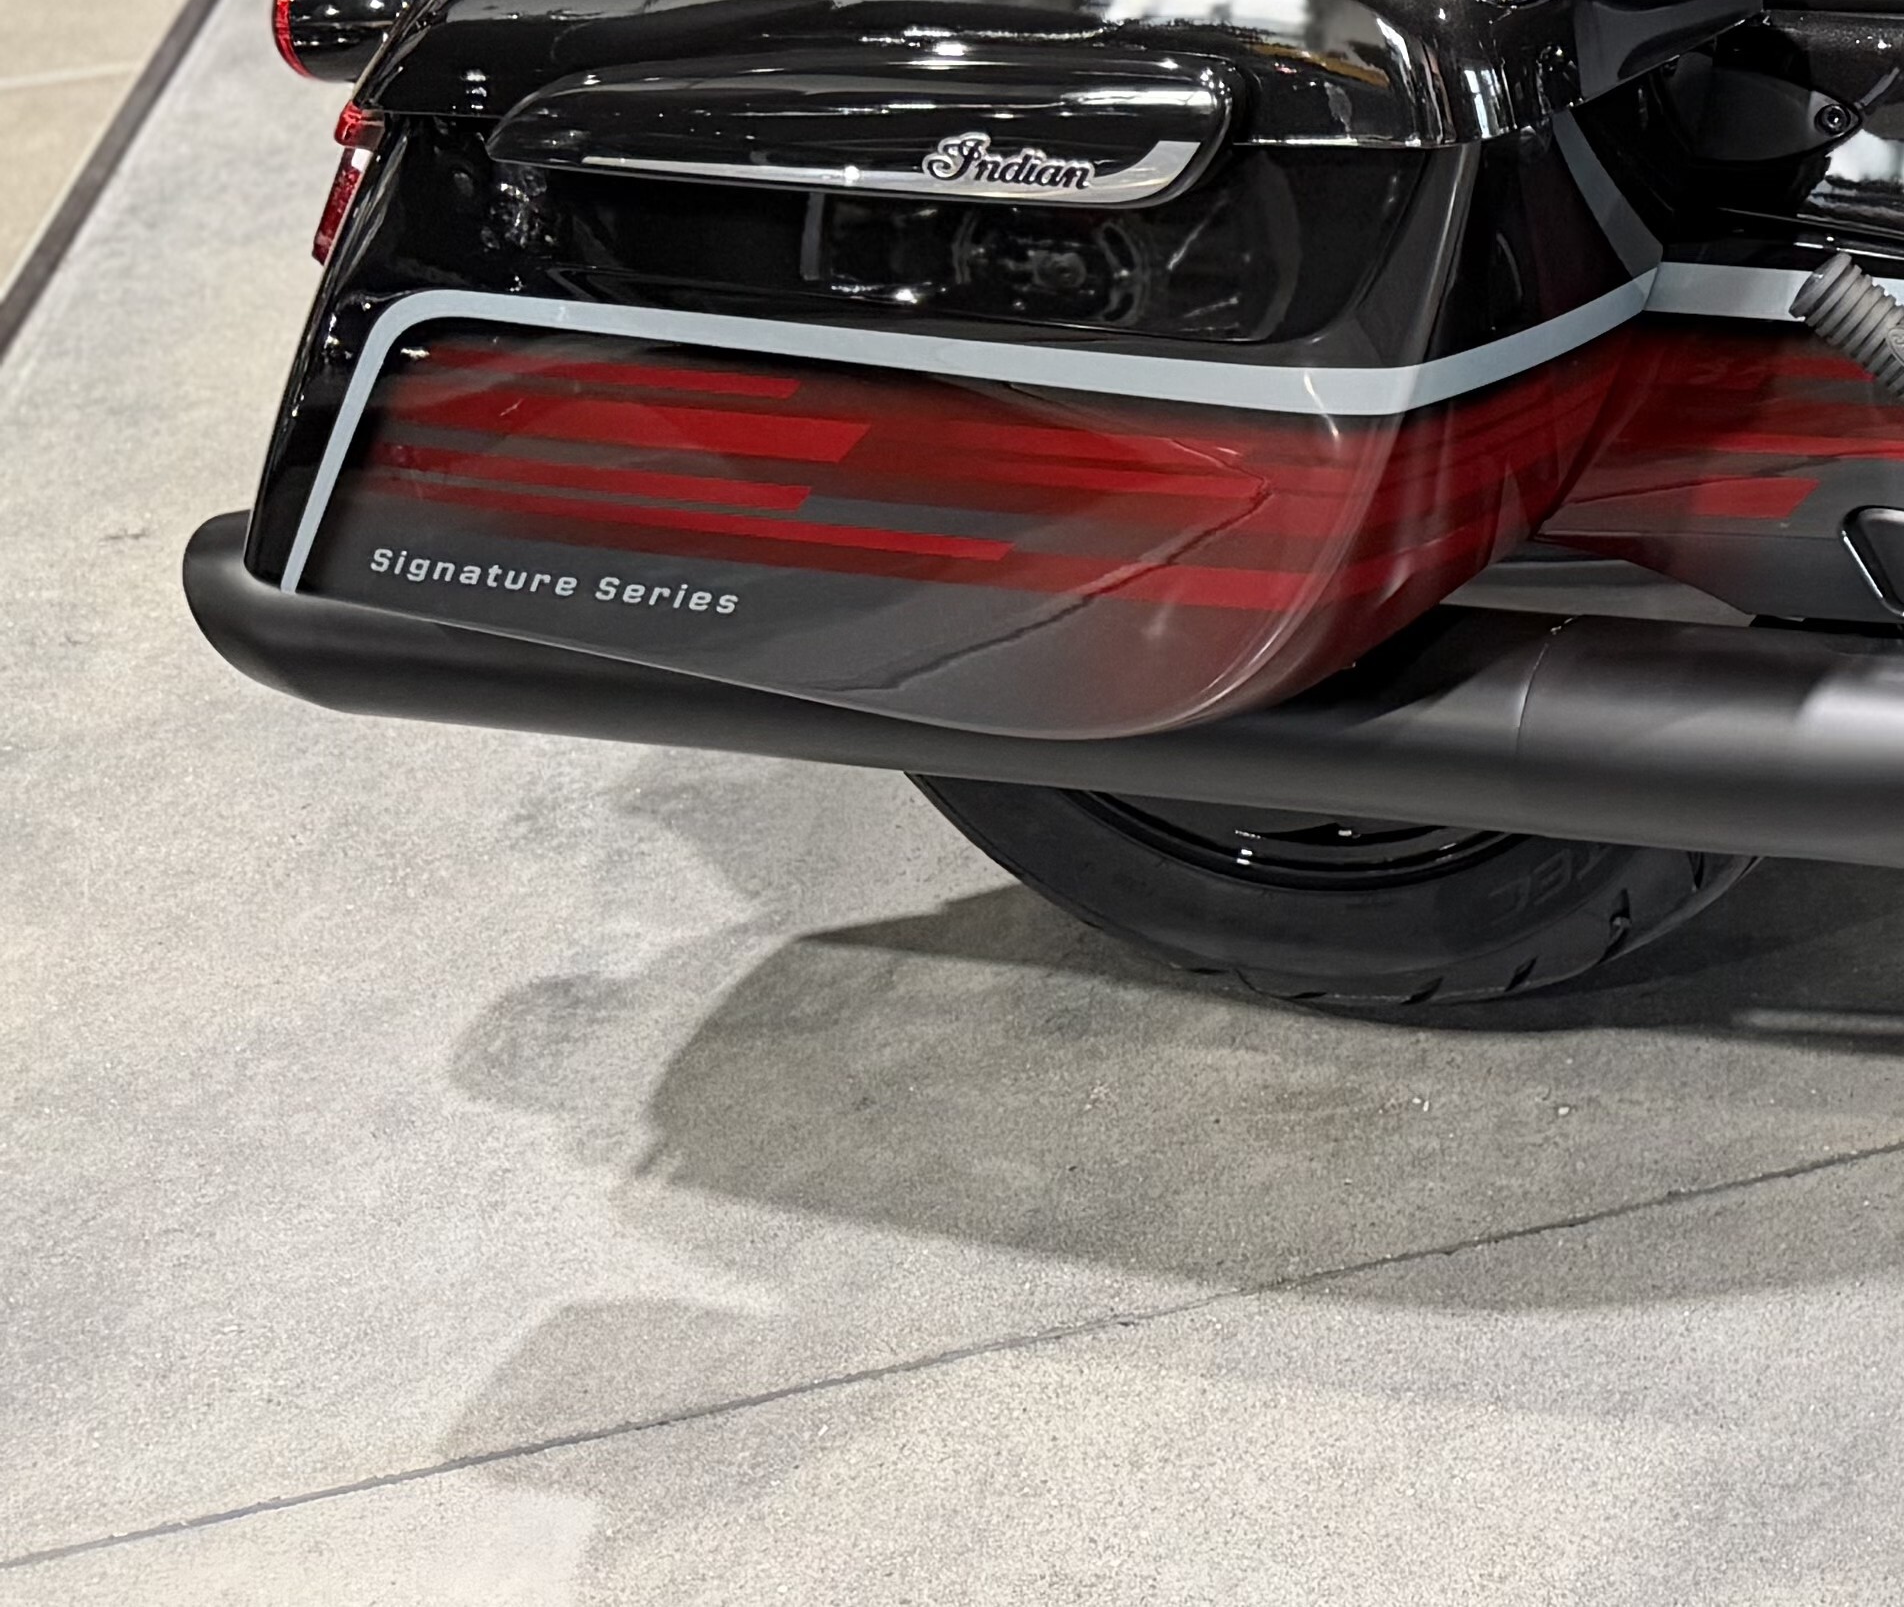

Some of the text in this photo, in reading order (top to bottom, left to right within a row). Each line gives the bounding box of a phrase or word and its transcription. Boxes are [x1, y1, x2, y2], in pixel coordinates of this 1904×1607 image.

[923, 132, 1094, 190] Indian
[370, 547, 740, 615] Signature Series
